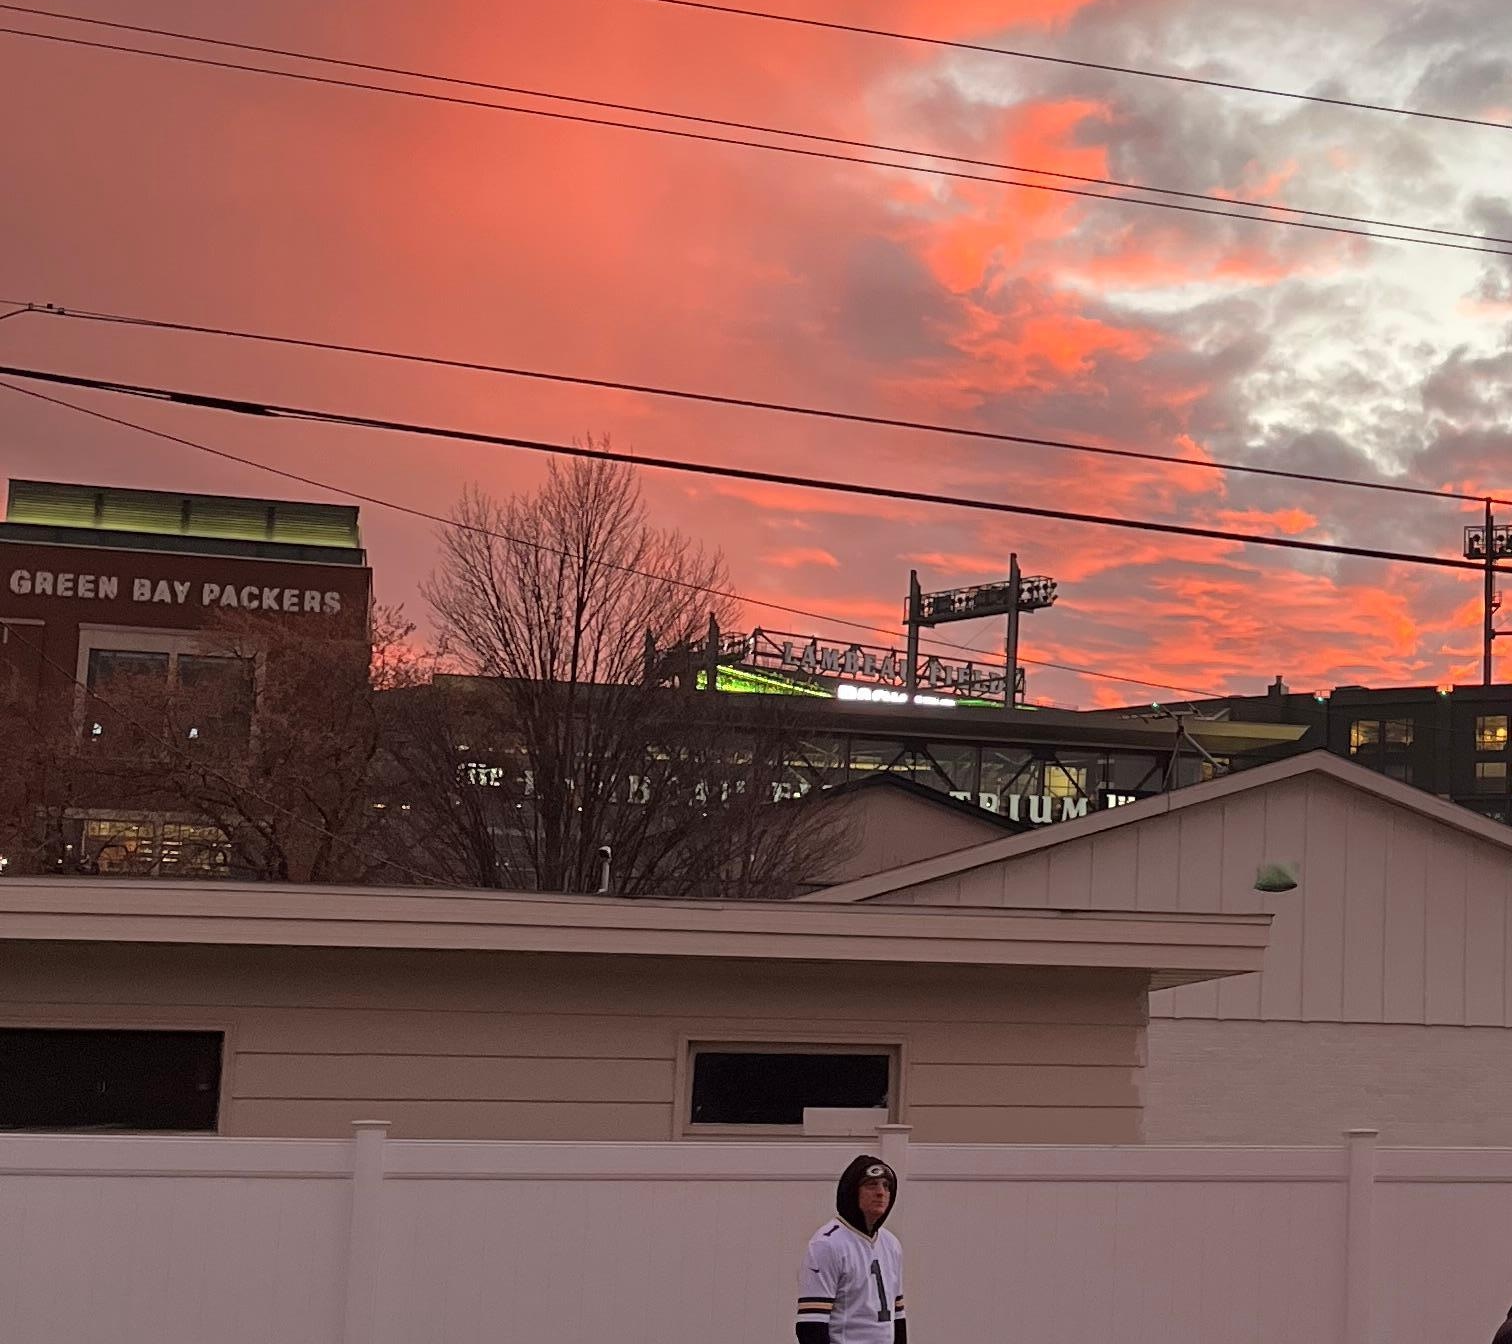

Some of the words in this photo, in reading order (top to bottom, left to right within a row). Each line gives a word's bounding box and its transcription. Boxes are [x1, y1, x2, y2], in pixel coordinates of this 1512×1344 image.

[10, 569, 118, 600] GREEN
[132, 578, 191, 605] BAY
[202, 583, 342, 614] PACKERS
[870, 1259, 892, 1322] 1
